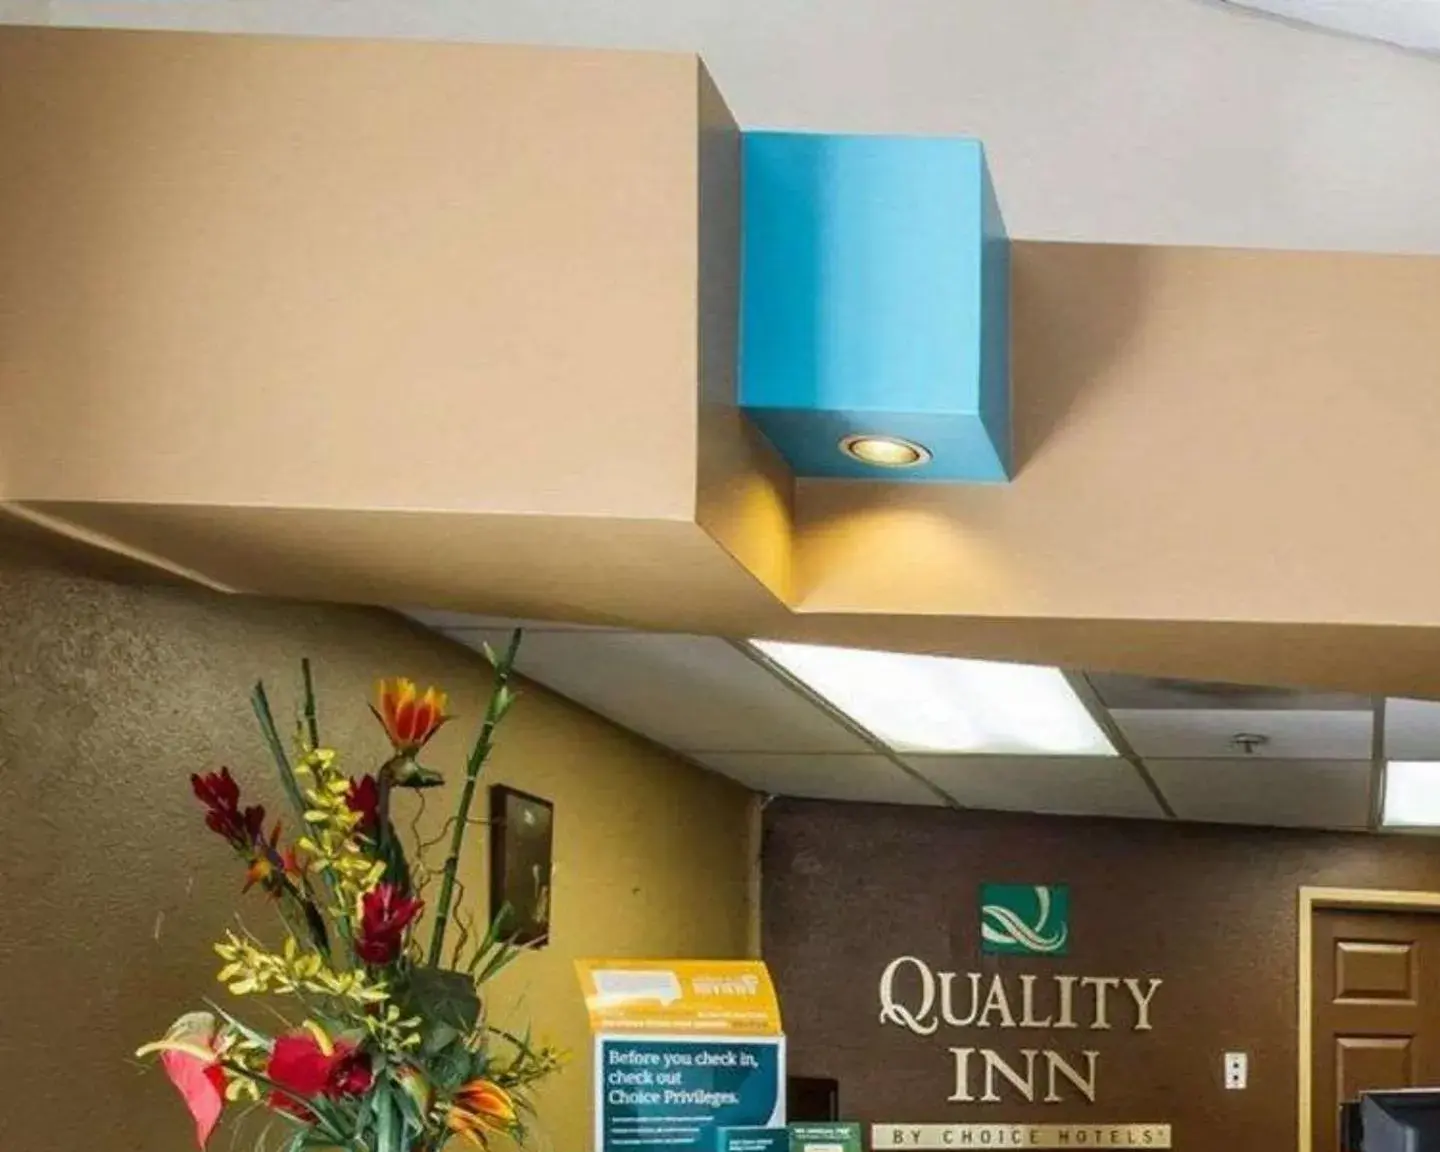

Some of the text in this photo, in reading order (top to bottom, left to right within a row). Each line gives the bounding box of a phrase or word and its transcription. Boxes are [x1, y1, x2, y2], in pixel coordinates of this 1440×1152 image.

[879, 956, 1163, 1035] QUALITY
[609, 1050, 759, 1068] Before you check in,
[608, 1069, 682, 1086] check out
[947, 1047, 1101, 1103] INN
[608, 1090, 661, 1105] Choice
[892, 1130, 922, 1145] BY
[942, 1129, 1039, 1145] CHOICE
